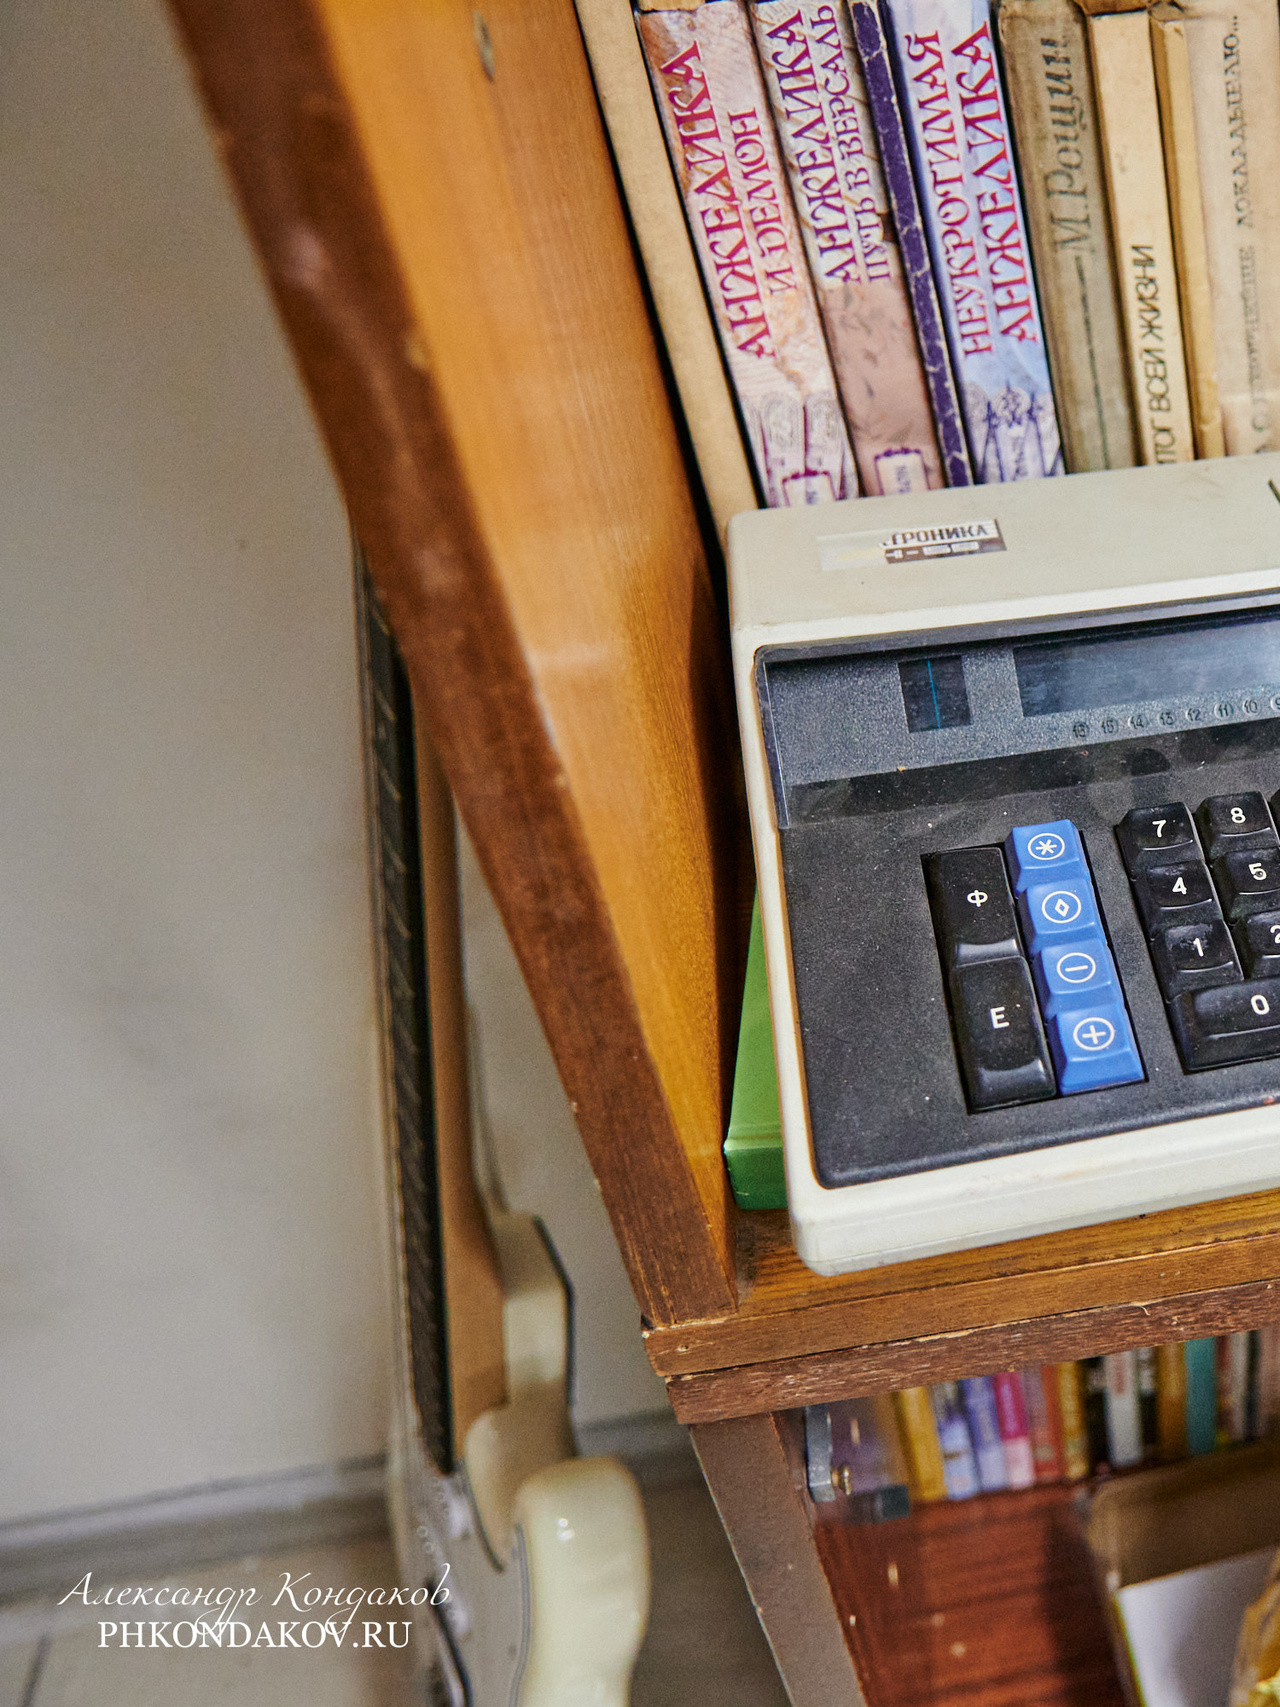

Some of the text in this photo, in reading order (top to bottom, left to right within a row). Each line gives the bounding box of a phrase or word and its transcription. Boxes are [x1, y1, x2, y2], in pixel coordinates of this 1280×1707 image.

[767, 9, 861, 285] АНЖЕЛИКА
[810, 4, 892, 282] ПУТЬ В ВЕРСАЛЬ
[661, 40, 776, 359] АНЖЕЛИКА
[728, 106, 798, 295] И ДЕМОН
[904, 30, 994, 356] НЕУКРОТИМАЯ
[952, 20, 1040, 345] АНЖЕЛИКА
[1130, 243, 1165, 341] ЖИЗНИ
[1142, 350, 1173, 413] ВСЕЙ
[1152, 819, 1167, 837] 7
[1231, 807, 1247, 825] 8
[1172, 876, 1188, 896] 4
[1249, 862, 1267, 882] 5
[966, 888, 989, 908] Ф
[1192, 937, 1205, 958] 1
[990, 1006, 1011, 1029] Е
[1250, 994, 1270, 1016] 0
